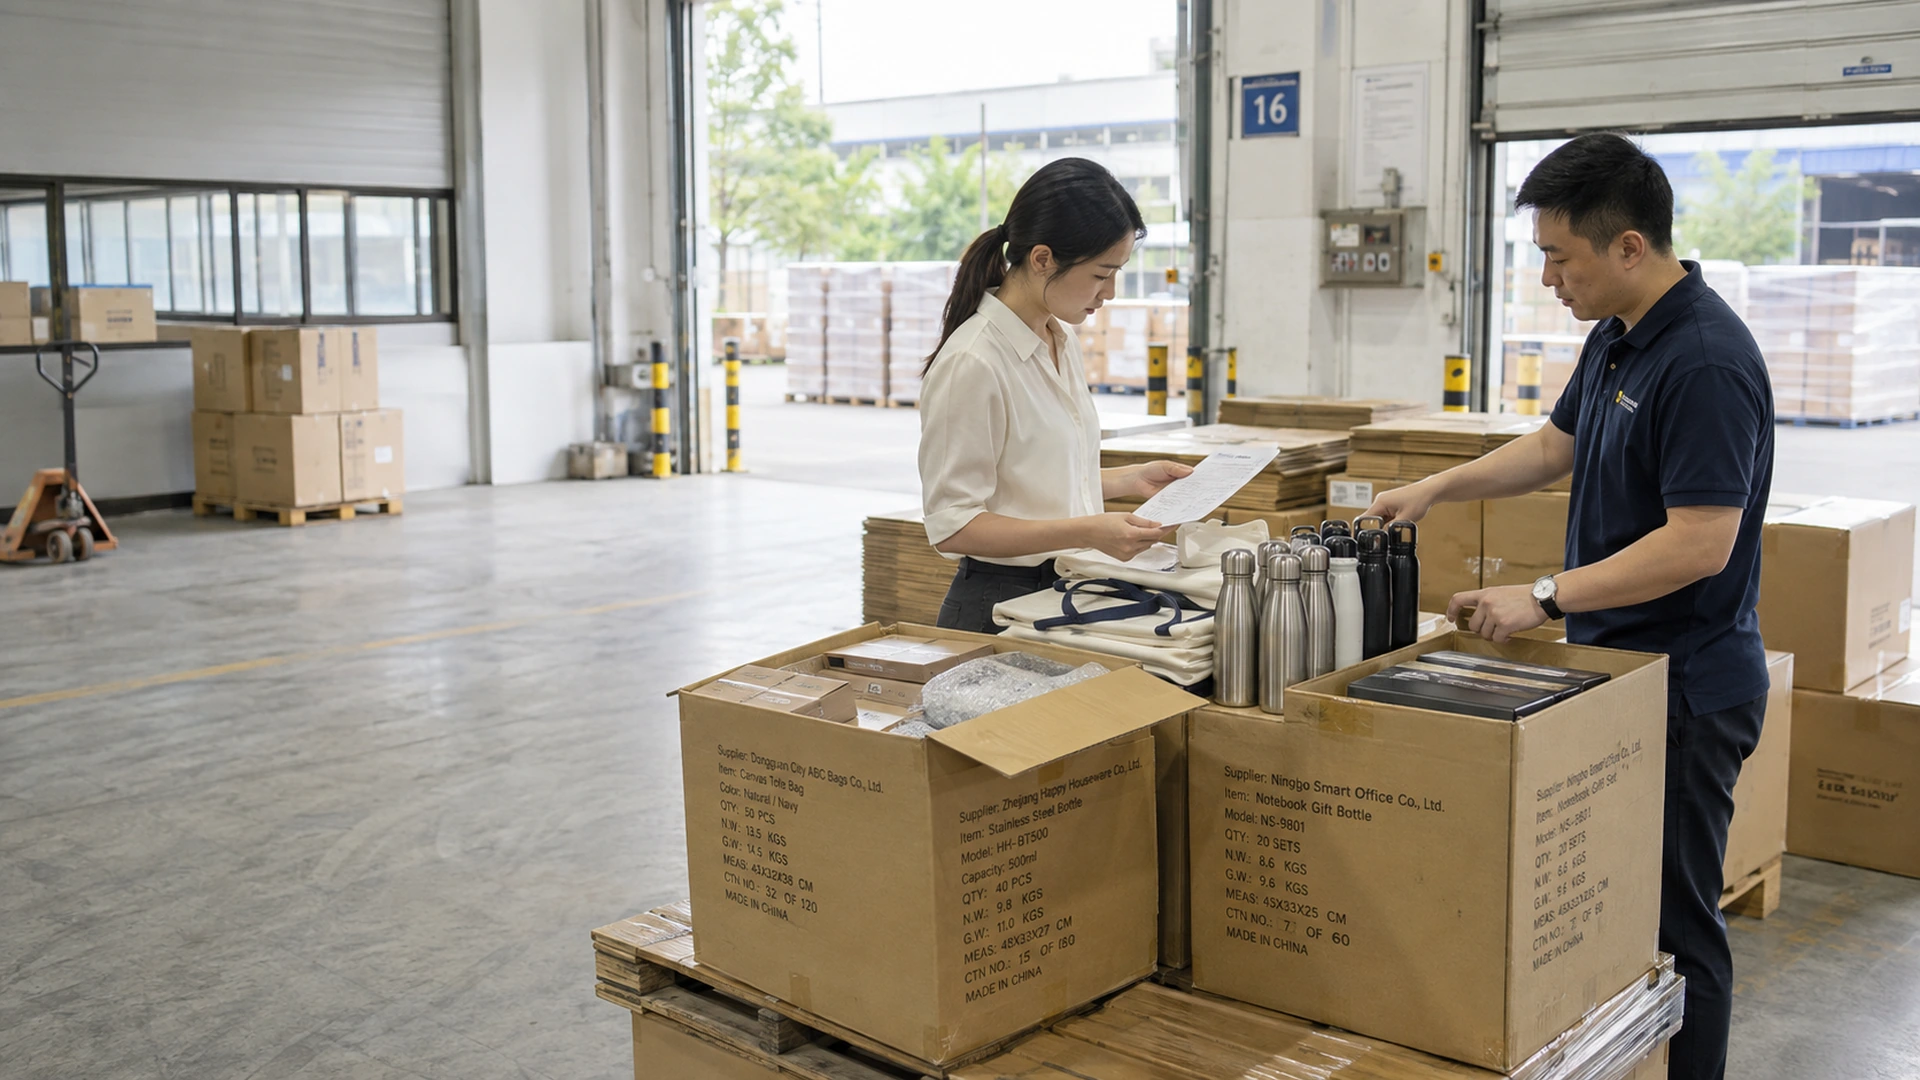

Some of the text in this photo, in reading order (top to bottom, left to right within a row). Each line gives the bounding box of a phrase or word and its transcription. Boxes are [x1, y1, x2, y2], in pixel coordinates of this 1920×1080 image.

[1253, 92, 1287, 126] 16
[788, 780, 804, 797] Bag
[808, 766, 826, 781] ABC
[828, 771, 848, 787] Bags
[868, 780, 884, 793] Ltd.
[1224, 766, 1445, 813] Supplier: Ningbo Smart Office Co., Ltd.
[772, 795, 776, 806] /
[778, 797, 799, 814] Navy
[959, 803, 1000, 824] Supplier:
[1040, 784, 1067, 800] Happy
[1068, 768, 1113, 790] Houseware
[1225, 787, 1372, 822] Item: Notebook Gift Bottle
[720, 800, 776, 825] QTY: 50 PCS
[960, 797, 1083, 844] Item: Stainless Steel Bottle
[1225, 808, 1305, 833] Model: NS-9801
[768, 831, 787, 847] KGS
[1225, 828, 1301, 854] QTY: 20 SETS
[769, 851, 788, 866] KGS
[961, 845, 994, 865] Model:
[961, 851, 1038, 886] Capacity: 500ml
[1259, 855, 1275, 869] 8.6
[1284, 861, 1308, 875] KGS
[723, 854, 749, 871] MEAS:
[799, 878, 814, 892] CM
[1259, 875, 1276, 889] 9.6
[1286, 881, 1309, 896] KGS
[765, 886, 777, 899] 32
[784, 893, 797, 905] OF
[801, 899, 818, 913] 120
[962, 872, 1033, 905] QTY: 40 PCS
[997, 899, 1013, 914] 9.8
[1022, 888, 1044, 905] KGS
[725, 889, 788, 921] MADE IN CHINA
[997, 917, 1015, 933] 11.0
[1023, 907, 1044, 924] KGS
[1226, 888, 1259, 905] MEAS:
[1327, 911, 1347, 925] CM
[964, 945, 997, 965] MEAS:
[1056, 915, 1073, 931] CM
[1226, 907, 1247, 921] CTN
[1284, 920, 1291, 932] 7
[1306, 926, 1323, 939] OF
[1332, 932, 1350, 946] 60
[1226, 926, 1308, 956] MADE IN CHINA
[965, 968, 986, 984] CTN
[1019, 950, 1031, 965] 15
[1040, 942, 1054, 957] OF
[965, 966, 1043, 1004] MADE IN CHINA
